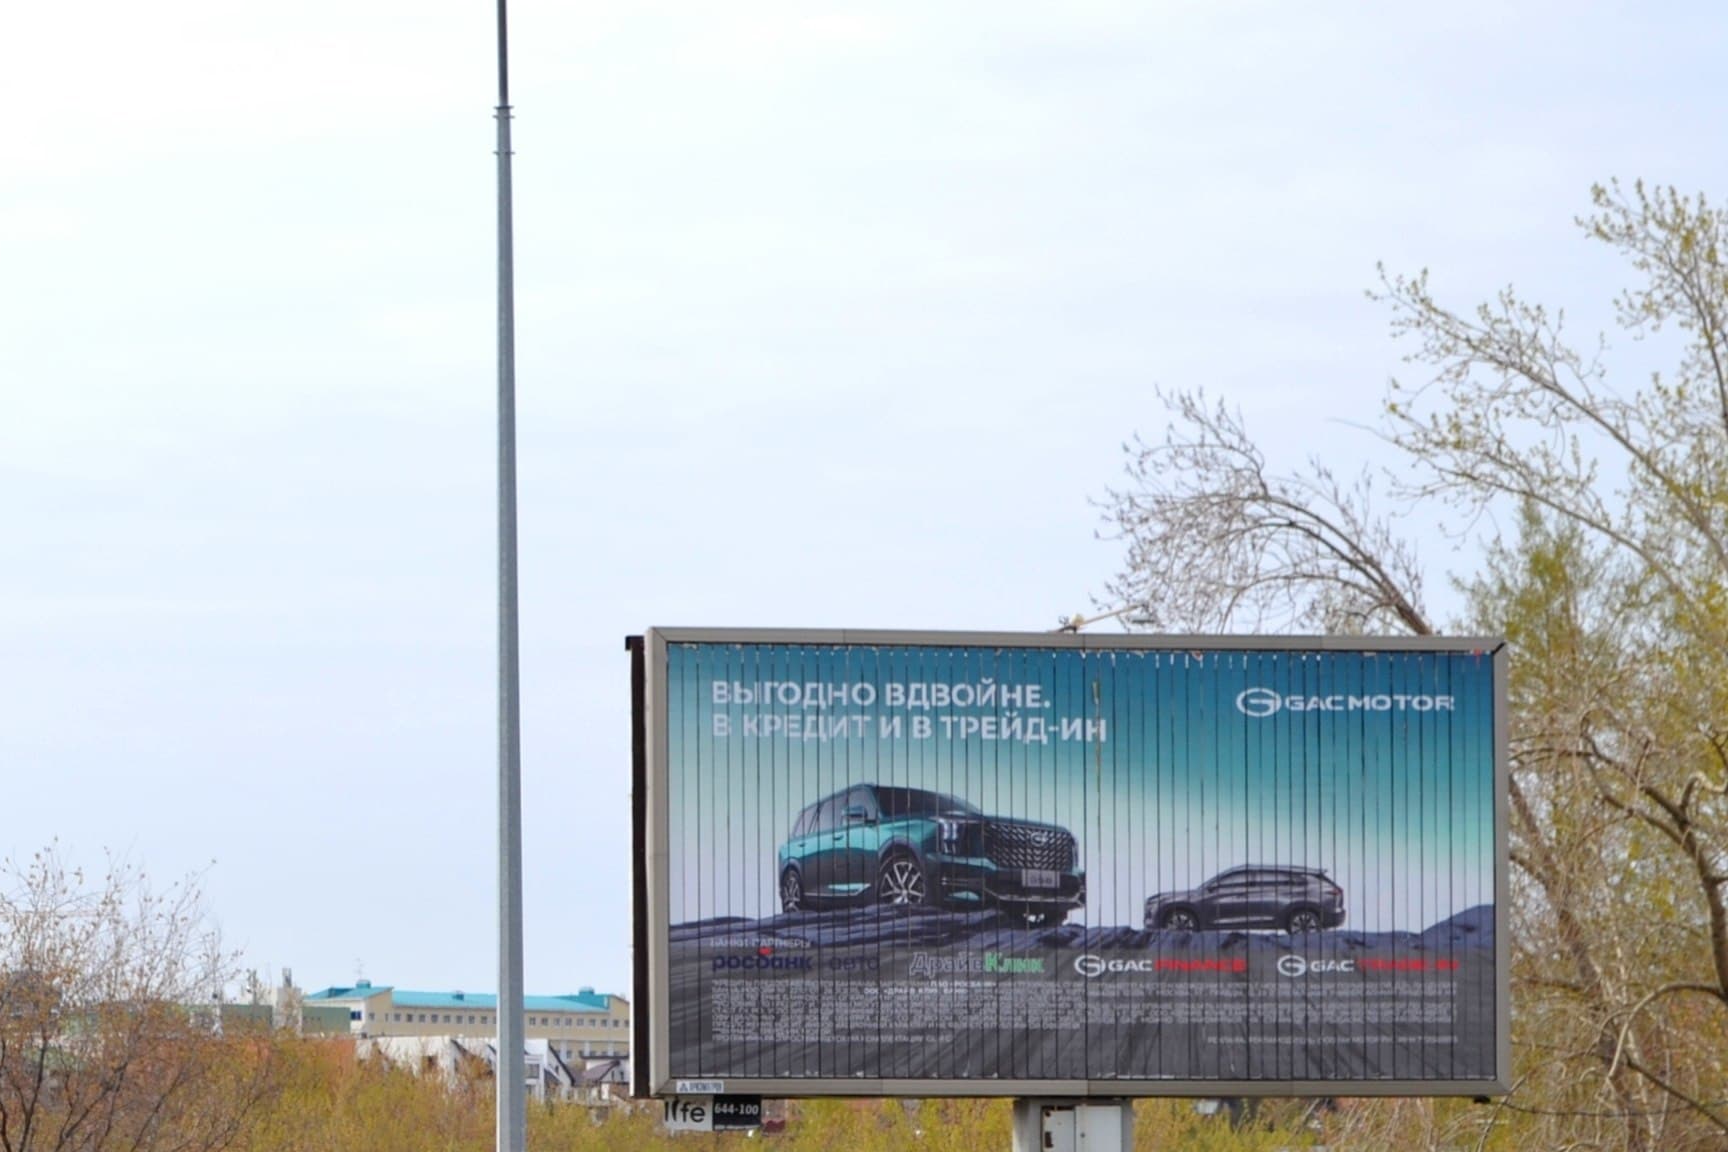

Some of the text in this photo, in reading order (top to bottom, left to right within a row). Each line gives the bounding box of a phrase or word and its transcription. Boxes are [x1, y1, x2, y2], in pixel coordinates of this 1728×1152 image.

[712, 677, 1051, 711] ВЫГОДНО ВДВОЙНЕ.
[713, 711, 1107, 744] В КРЕДИТ И В ТРЕЙД-ИН
[1107, 959, 1153, 973] GAC
[1310, 959, 1355, 973] GAC
[714, 1103, 760, 1115] 644-100
